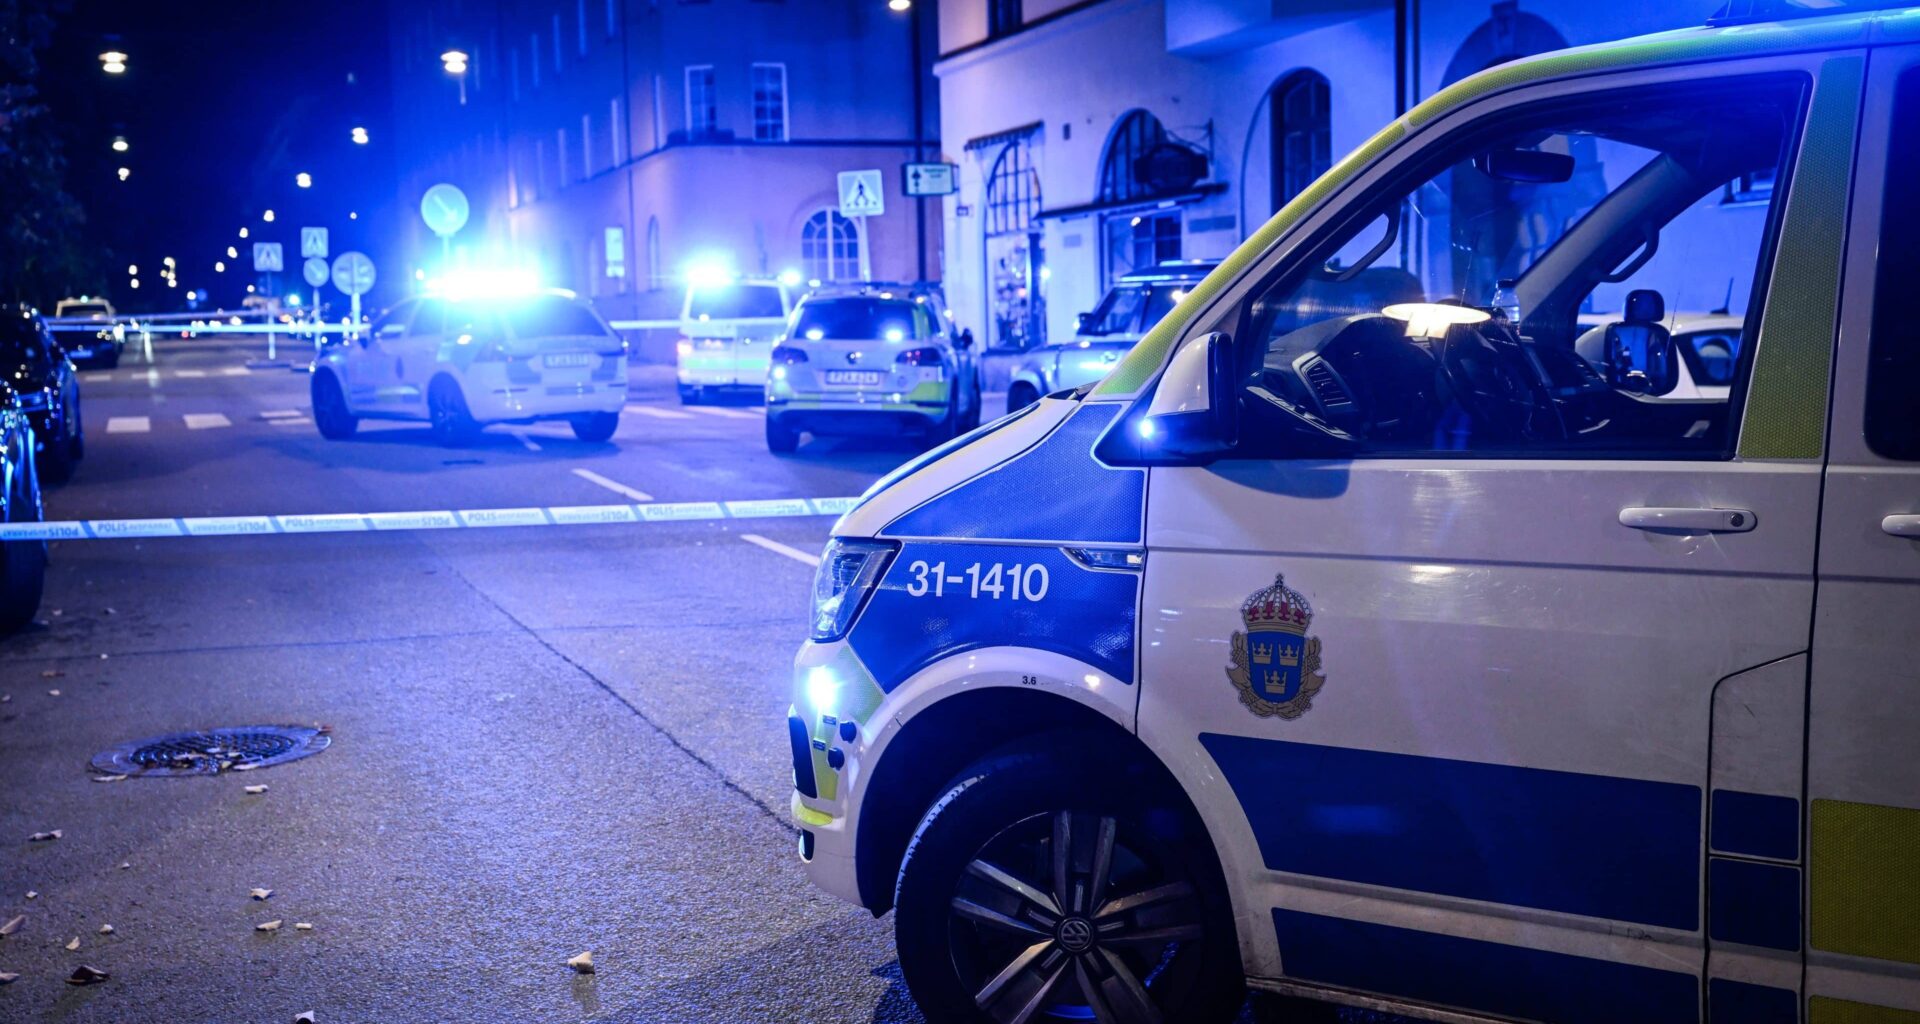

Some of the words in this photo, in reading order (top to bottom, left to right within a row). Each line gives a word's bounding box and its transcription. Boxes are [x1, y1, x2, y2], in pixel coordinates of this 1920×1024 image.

[646, 506, 674, 515] POLIS
[468, 512, 497, 521] POLIS
[601, 511, 629, 521] POLIS
[238, 521, 267, 531] POLIS
[285, 518, 314, 527] POLIS
[421, 517, 450, 527] POLIS
[98, 523, 127, 532] POLIS
[907, 560, 1049, 601] 31-1410
[1022, 675, 1037, 685] 3.6
